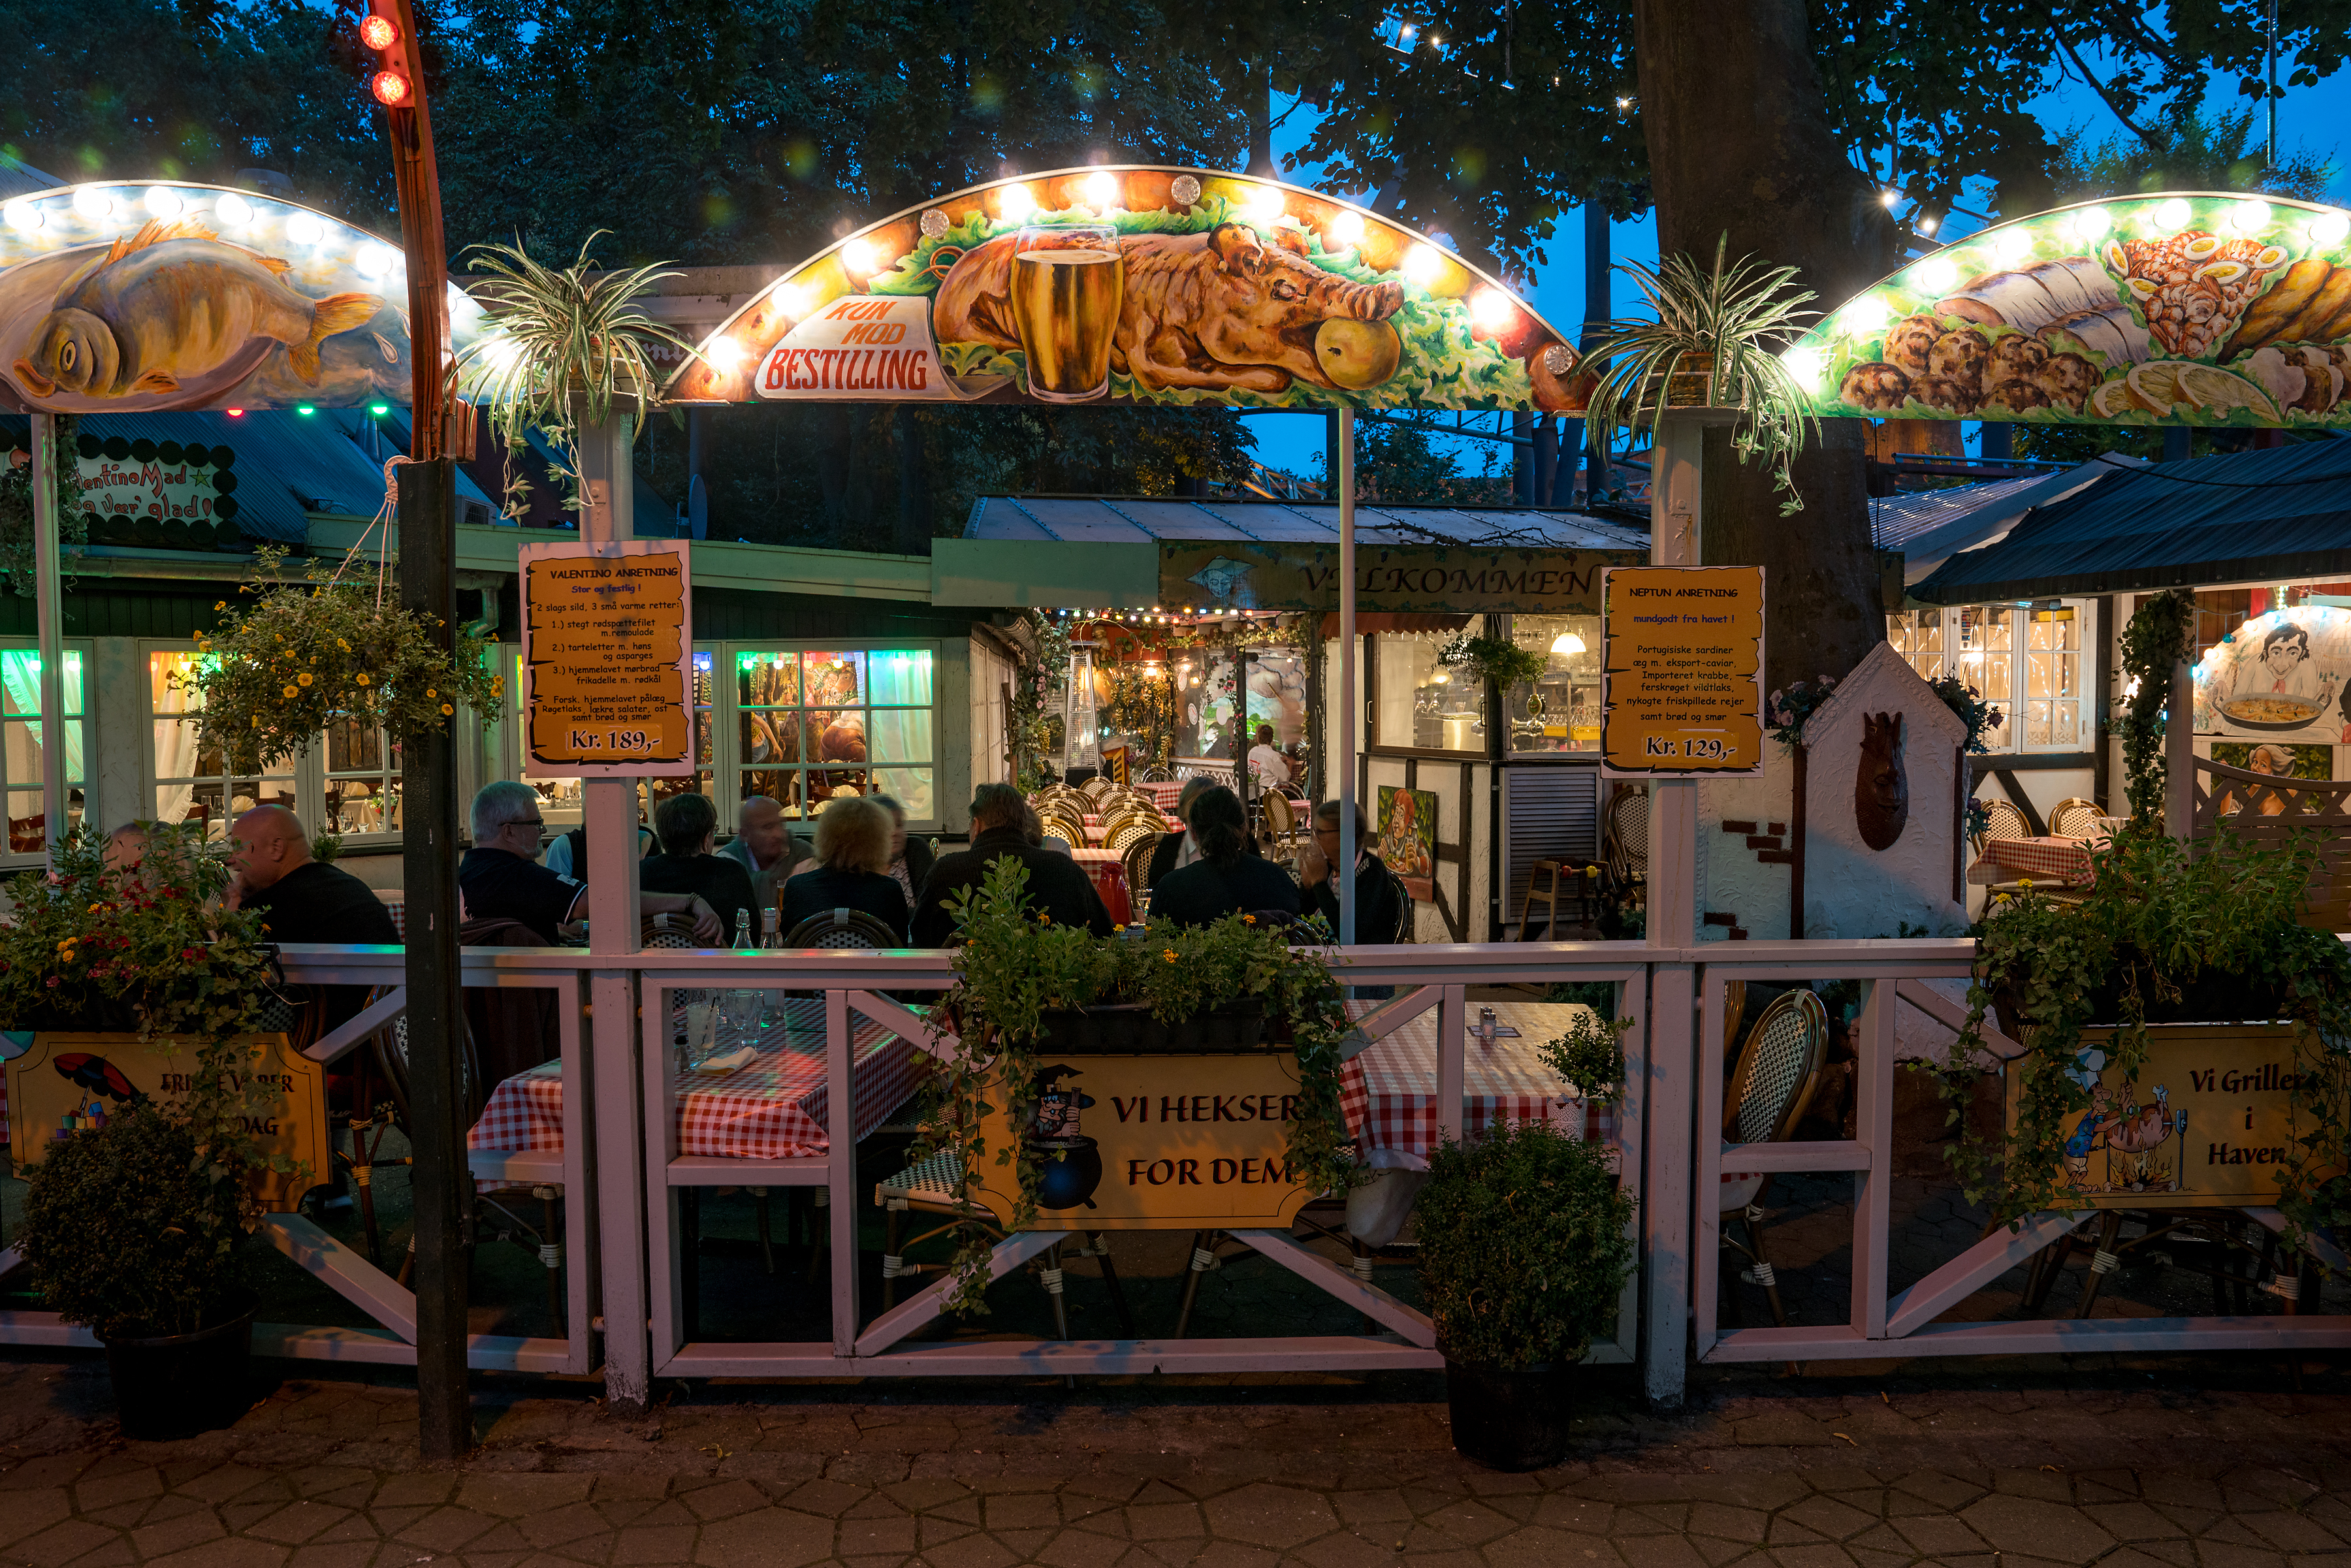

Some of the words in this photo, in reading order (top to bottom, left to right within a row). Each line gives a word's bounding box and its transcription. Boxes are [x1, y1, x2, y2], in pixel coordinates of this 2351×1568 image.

[825, 301, 897, 321] KUN
[840, 324, 906, 345] MOD
[765, 349, 927, 390] BESTILLING
[551, 569, 611, 579] VALENTINO
[616, 568, 678, 577] ANRETNING
[1298, 564, 1603, 596] VLKOMMEN
[594, 586, 605, 596] og
[607, 584, 635, 595] festlig
[1676, 588, 1738, 597] ANRETNING
[547, 604, 566, 613] slags
[601, 600, 616, 610] små
[568, 621, 589, 630] stegt
[594, 618, 655, 629] rødspættefilet
[1634, 614, 1678, 625] mundgodt
[1682, 615, 1697, 623] fra
[1702, 615, 1727, 623] havet
[1638, 645, 1691, 656] Portugisiske
[569, 665, 621, 675] hjemmelavet
[625, 664, 660, 673] mørbrad
[577, 676, 616, 684] frikadelle
[635, 675, 660, 683] rødkål
[1642, 671, 1693, 681] Importeret
[1641, 682, 1689, 693] ferskrøget
[584, 695, 636, 705] hjemmelavet
[641, 694, 665, 704] pålæg
[1627, 696, 1661, 707] nykogte
[1666, 697, 1716, 707] friskpillede
[1721, 697, 1744, 707] rejer
[573, 731, 601, 748] Kr.
[1648, 737, 1676, 754] Kr.
[2190, 1068, 2216, 1093] Vi
[2221, 1063, 2307, 1094] Griller
[1110, 1095, 1148, 1123] VI
[1160, 1095, 1306, 1123] HEKSER
[2245, 1106, 2254, 1130] i
[2209, 1143, 2286, 1165] Haven
[1128, 1159, 1202, 1185] FOR
[1209, 1157, 1294, 1185] DEM
